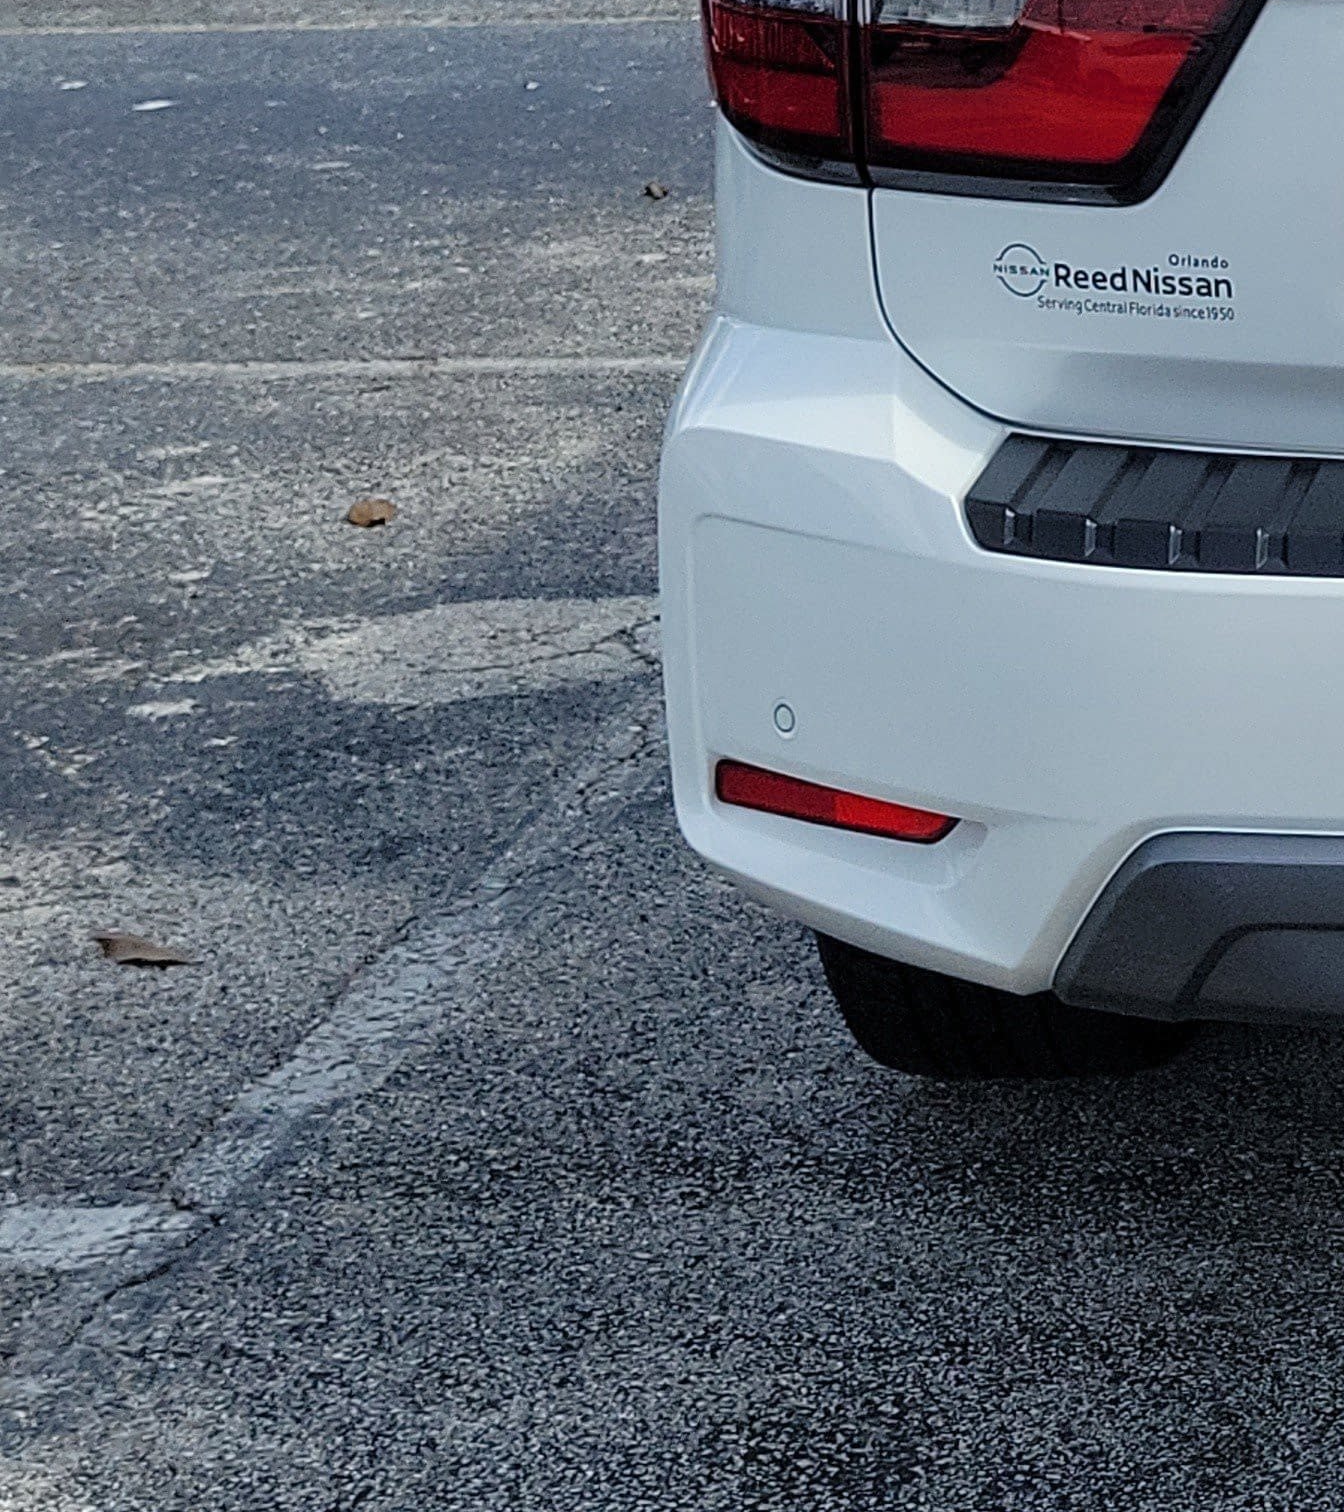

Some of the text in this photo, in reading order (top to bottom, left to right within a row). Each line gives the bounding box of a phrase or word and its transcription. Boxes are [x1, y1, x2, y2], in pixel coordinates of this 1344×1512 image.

[992, 263, 1050, 277] NISSAN
[1168, 253, 1229, 269] Orlando
[1053, 262, 1232, 299] Reed Nissan
[1037, 295, 1083, 316] Serving
[1084, 298, 1128, 314] Central
[1129, 301, 1171, 318] Florida
